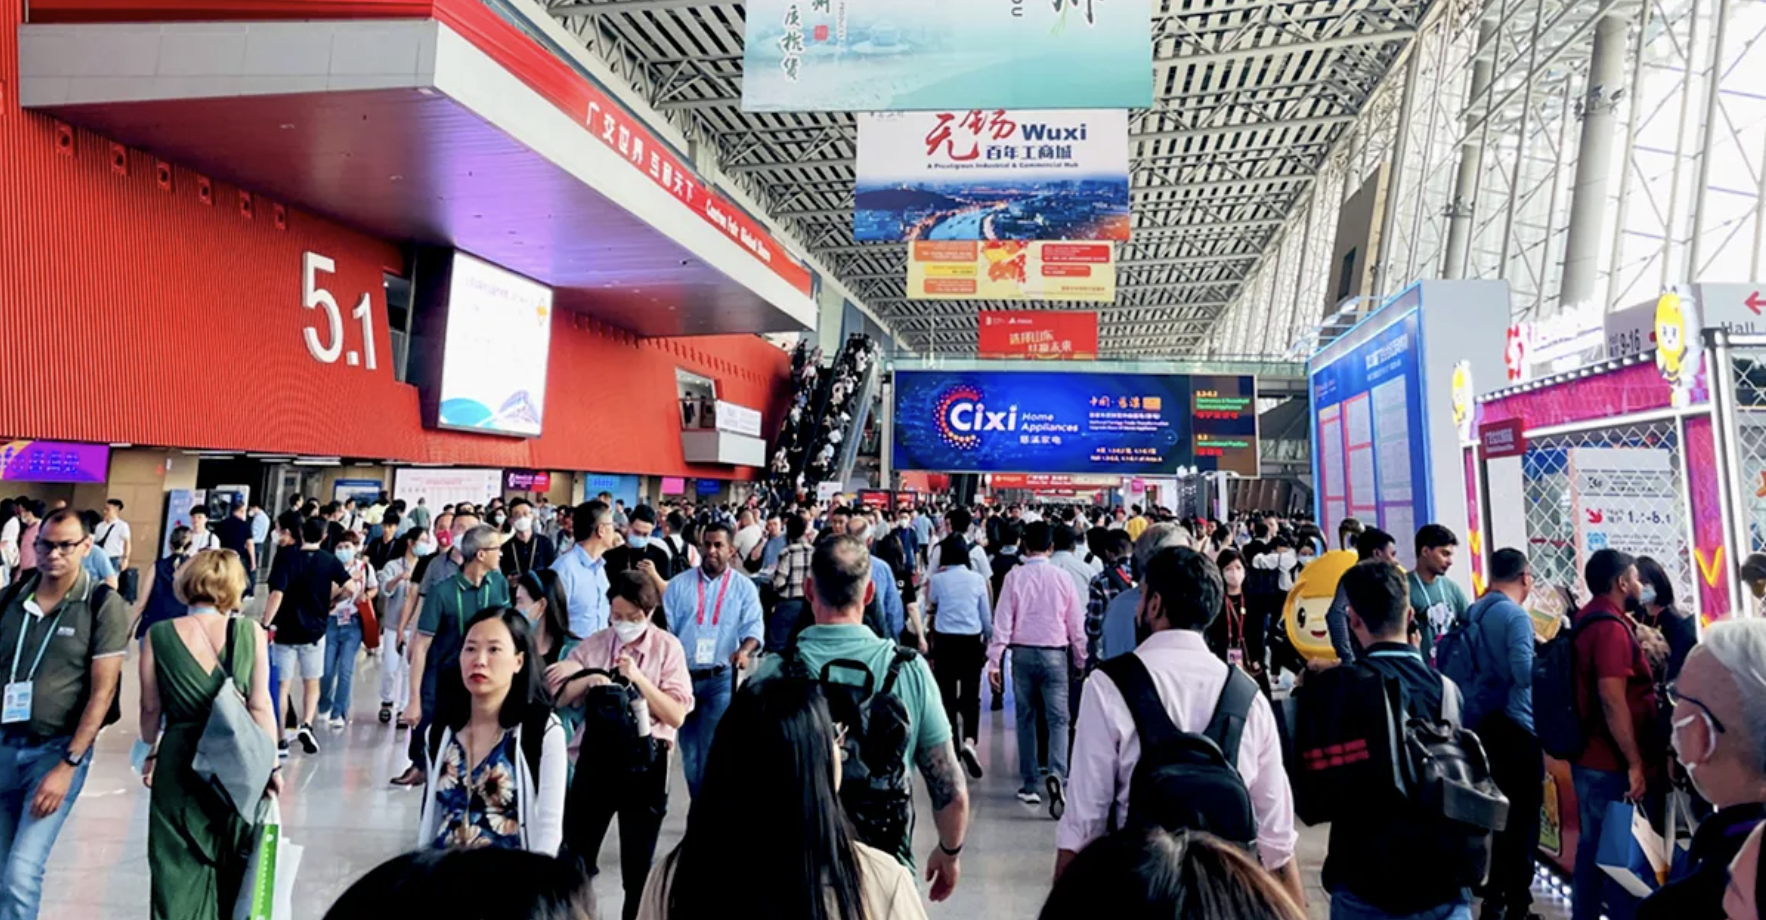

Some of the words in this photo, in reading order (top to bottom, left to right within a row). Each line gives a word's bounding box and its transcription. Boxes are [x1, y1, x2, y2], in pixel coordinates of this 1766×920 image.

[1021, 123, 1087, 142] Wuxi
[985, 144, 1073, 161] 百年工商城
[303, 251, 377, 370] 5.1
[1619, 327, 1642, 356] 9-16
[949, 402, 1018, 432] Cixi
[1022, 412, 1055, 421] Home
[1021, 422, 1079, 434] Appliances
